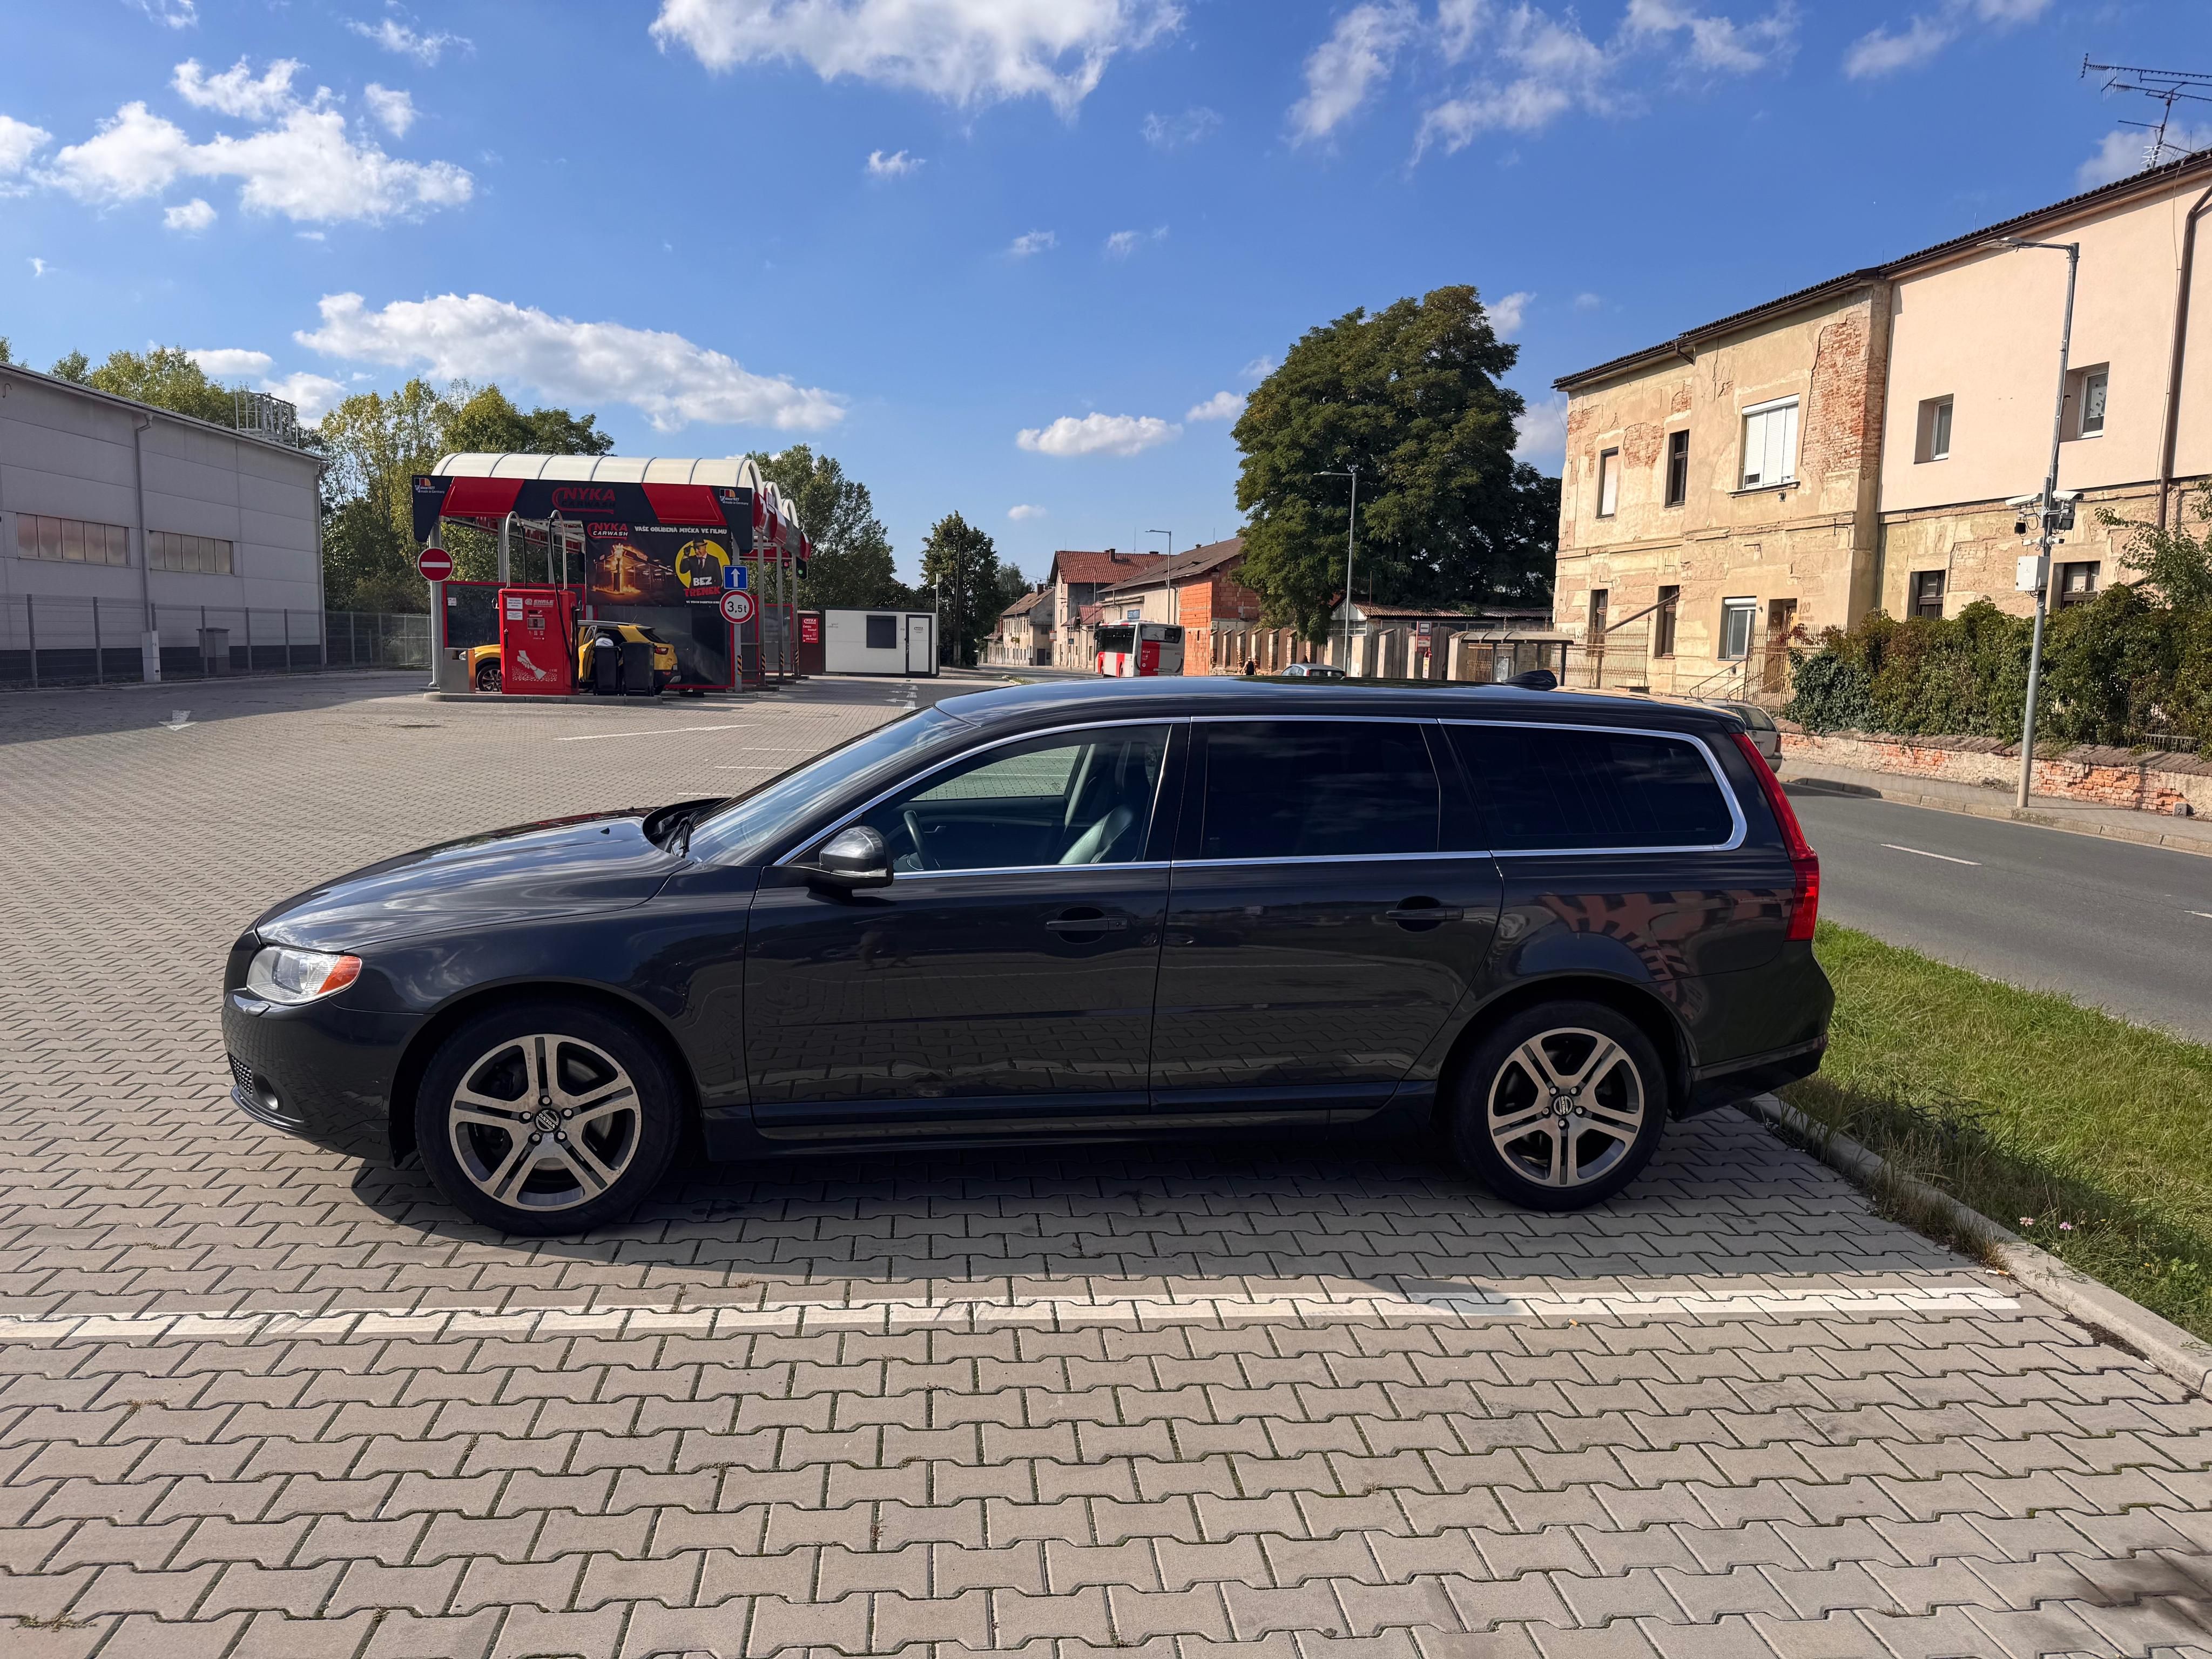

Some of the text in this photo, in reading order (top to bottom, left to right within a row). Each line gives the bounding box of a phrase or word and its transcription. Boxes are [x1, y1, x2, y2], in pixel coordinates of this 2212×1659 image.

[563, 487, 616, 502] NYKA
[594, 522, 628, 531] NYKA
[693, 576, 712, 586] BEZ
[683, 586, 721, 597] TRENEK
[1799, 602, 1811, 615] 220
[538, 1113, 555, 1129] VOLVO
